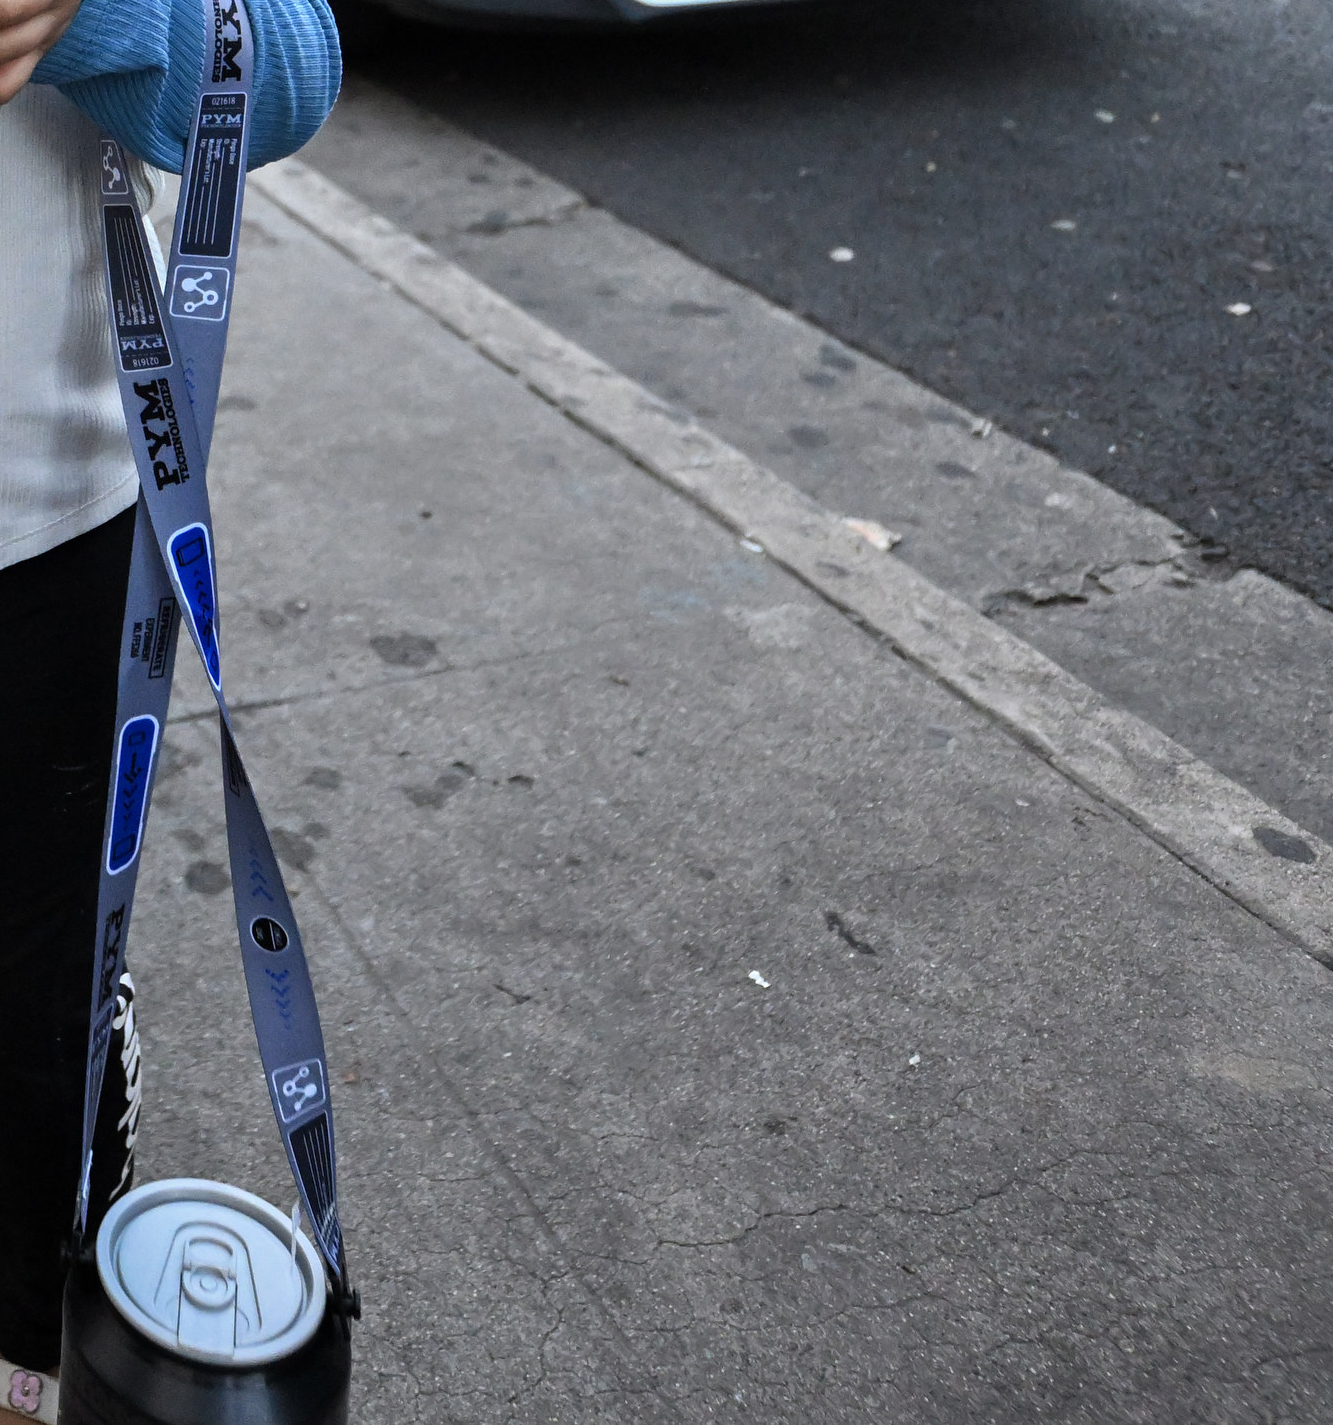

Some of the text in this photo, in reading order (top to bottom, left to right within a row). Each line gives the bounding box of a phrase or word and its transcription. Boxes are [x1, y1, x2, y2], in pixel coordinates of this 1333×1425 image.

[211, 97, 236, 106] 021618
[201, 114, 243, 124] PYM
[121, 337, 164, 350] PYM
[133, 357, 159, 367] 021618
[133, 380, 180, 491] PYM
[158, 378, 189, 483] TECHNOLOGIES
